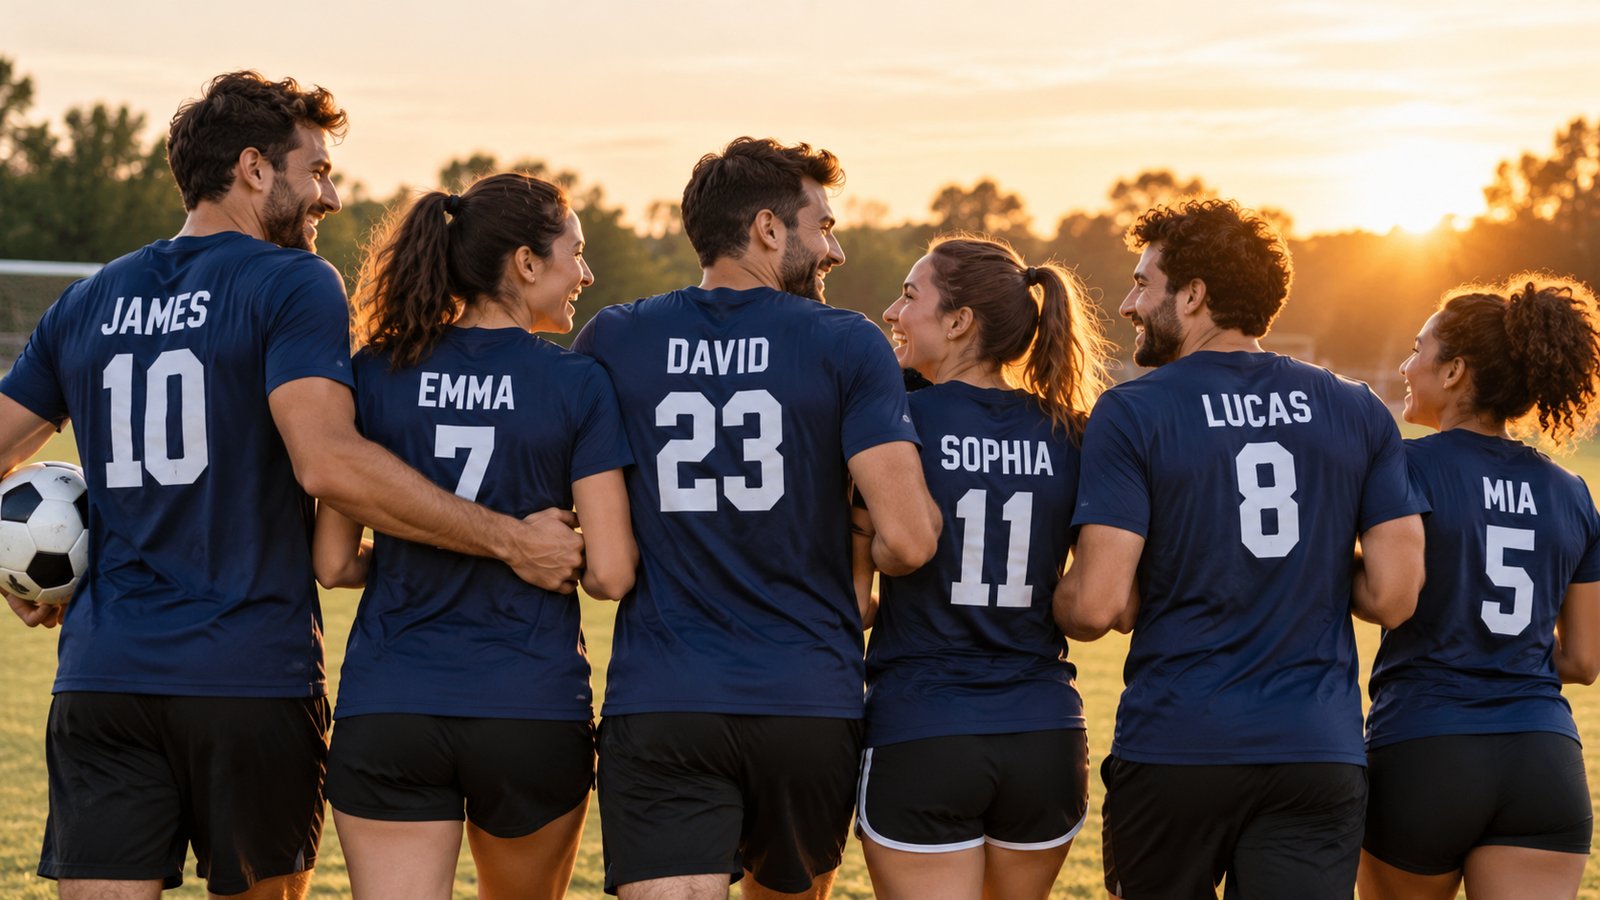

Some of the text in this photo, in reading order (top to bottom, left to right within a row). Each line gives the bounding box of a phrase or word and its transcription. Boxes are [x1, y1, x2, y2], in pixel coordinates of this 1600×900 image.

[101, 290, 211, 336] JAMES
[666, 337, 770, 376] DAVID
[102, 348, 209, 489] 10
[417, 371, 515, 410] EMMA
[1201, 390, 1312, 428] LUCAS
[434, 424, 495, 502] 7
[655, 389, 785, 512] 23
[941, 434, 1054, 476] SOPHIA
[1235, 441, 1300, 559] 8
[1482, 476, 1538, 515] MIA
[950, 488, 1034, 608] 11
[1480, 524, 1535, 636] 5
